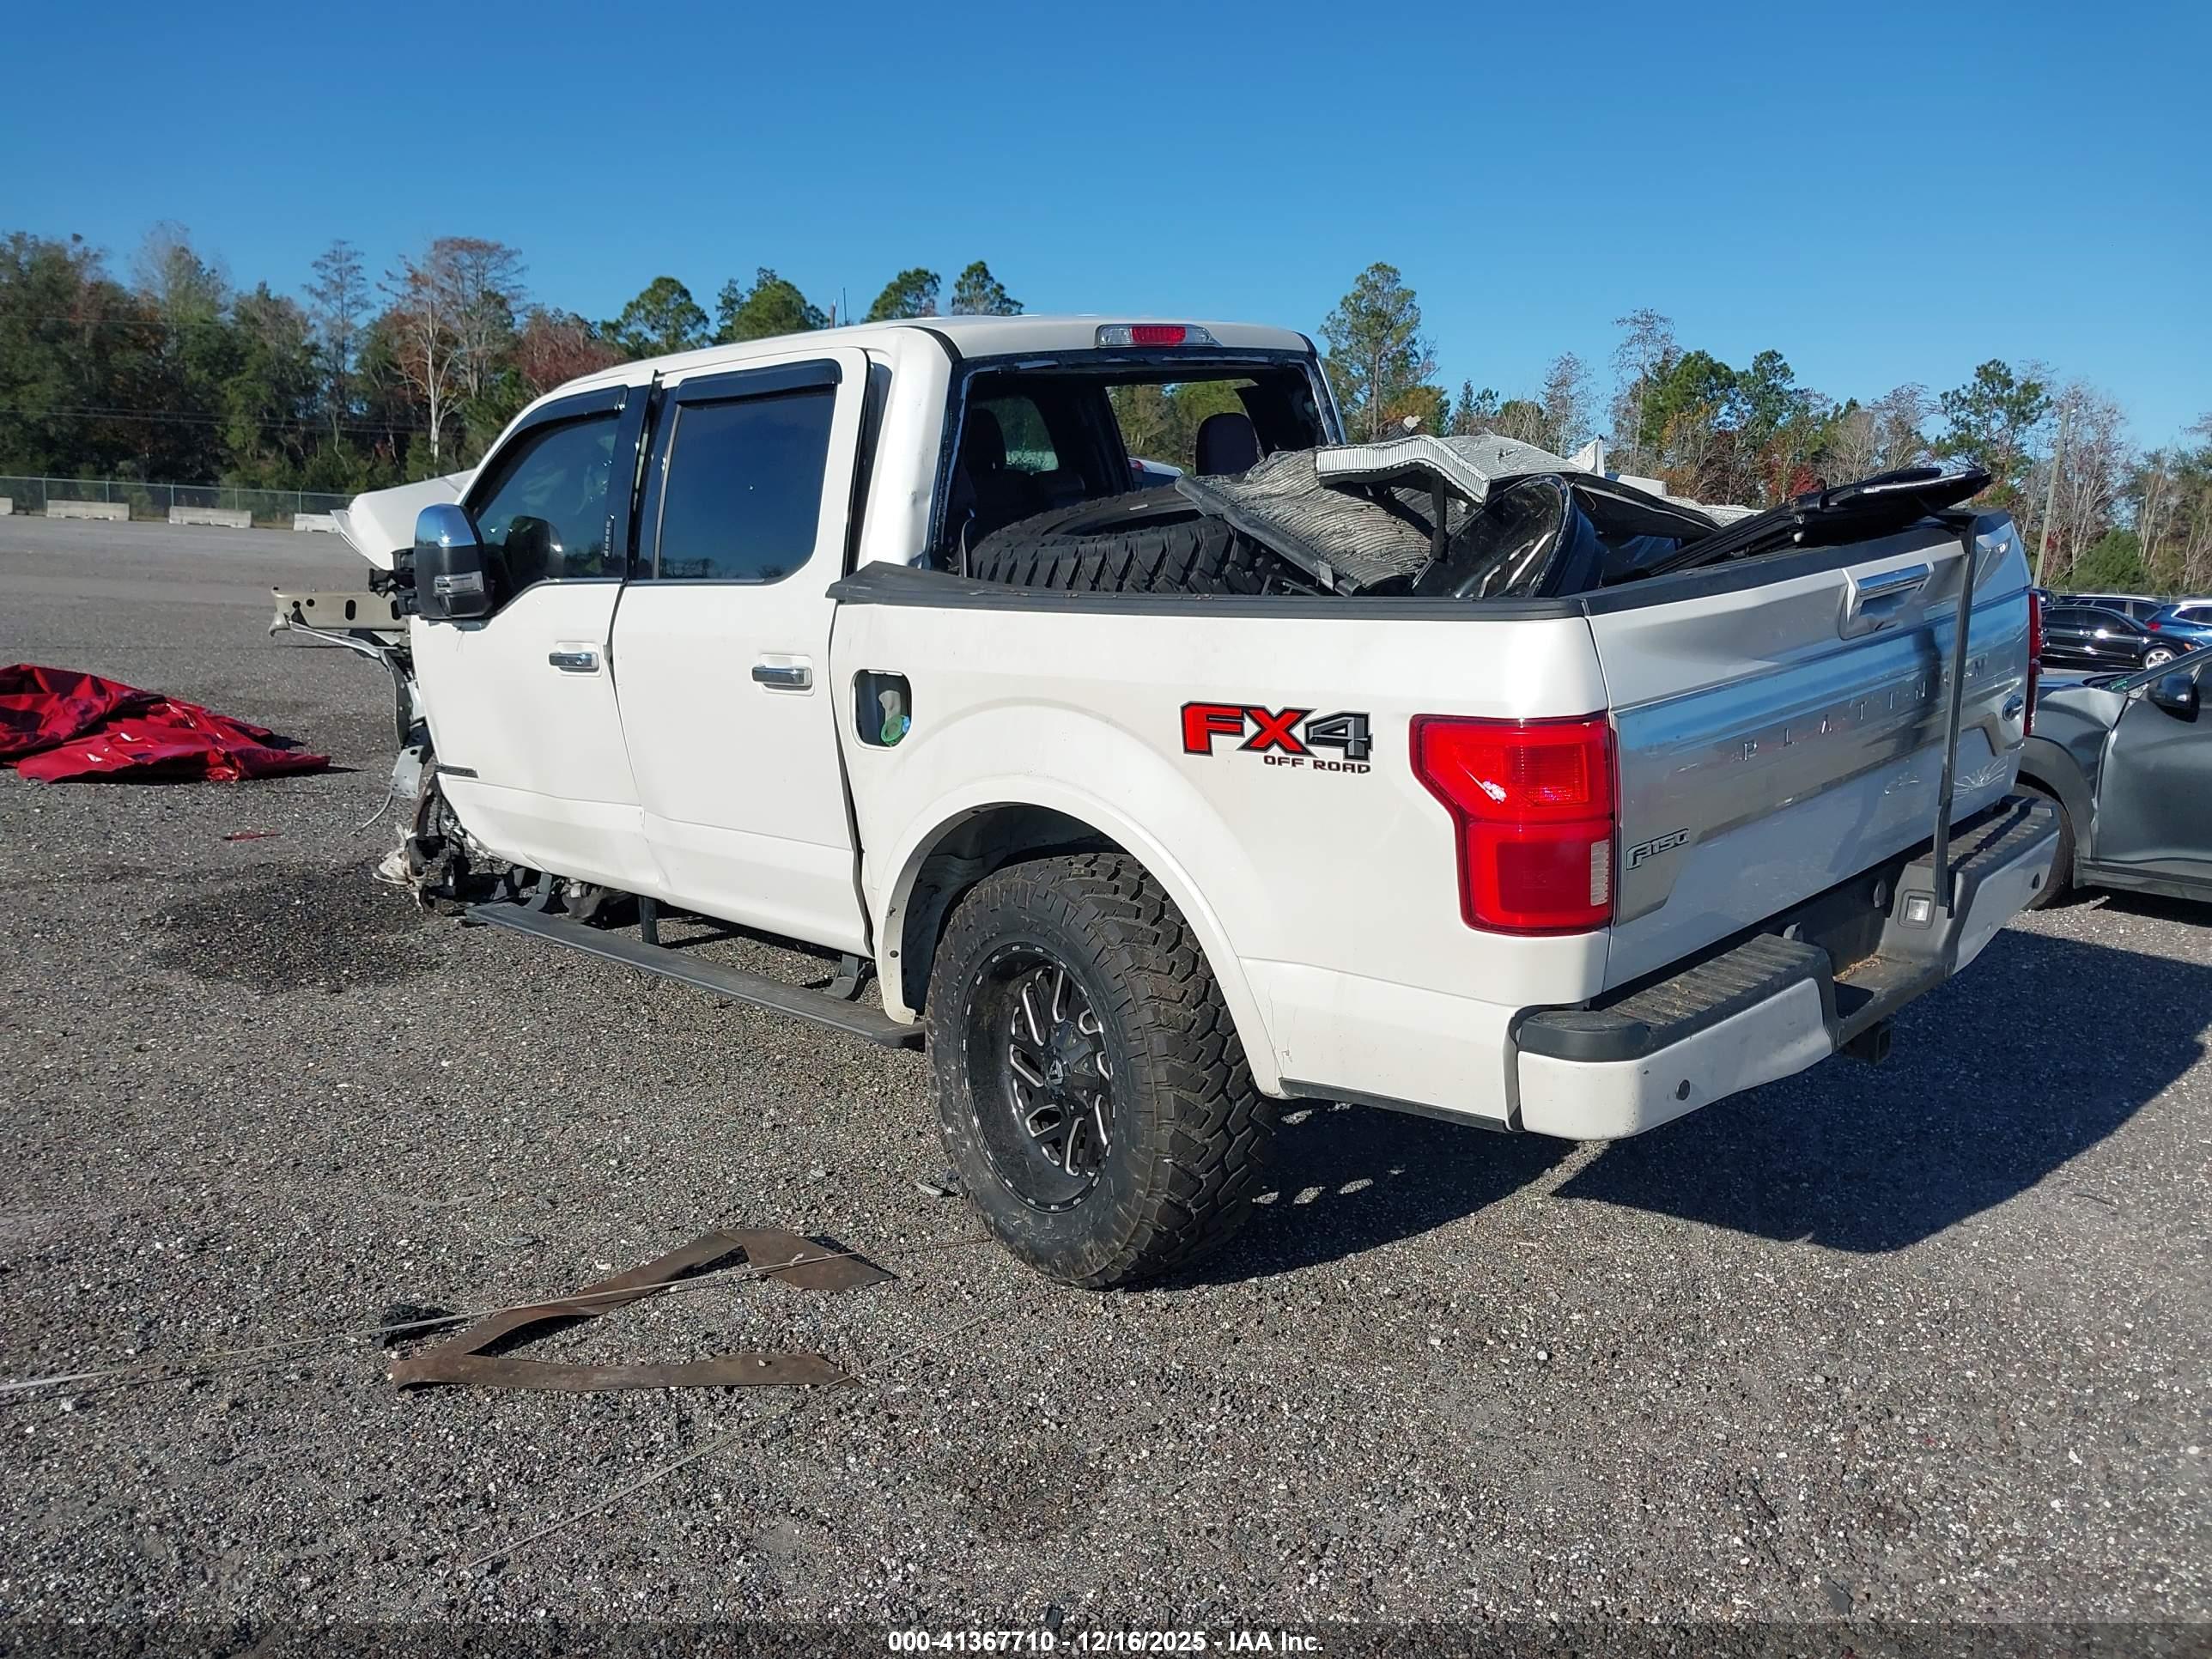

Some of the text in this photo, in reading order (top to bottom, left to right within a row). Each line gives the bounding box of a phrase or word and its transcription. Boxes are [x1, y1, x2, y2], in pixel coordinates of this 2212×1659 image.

[1180, 701, 1373, 762] FX4
[1263, 754, 1371, 775] OFF ROAD
